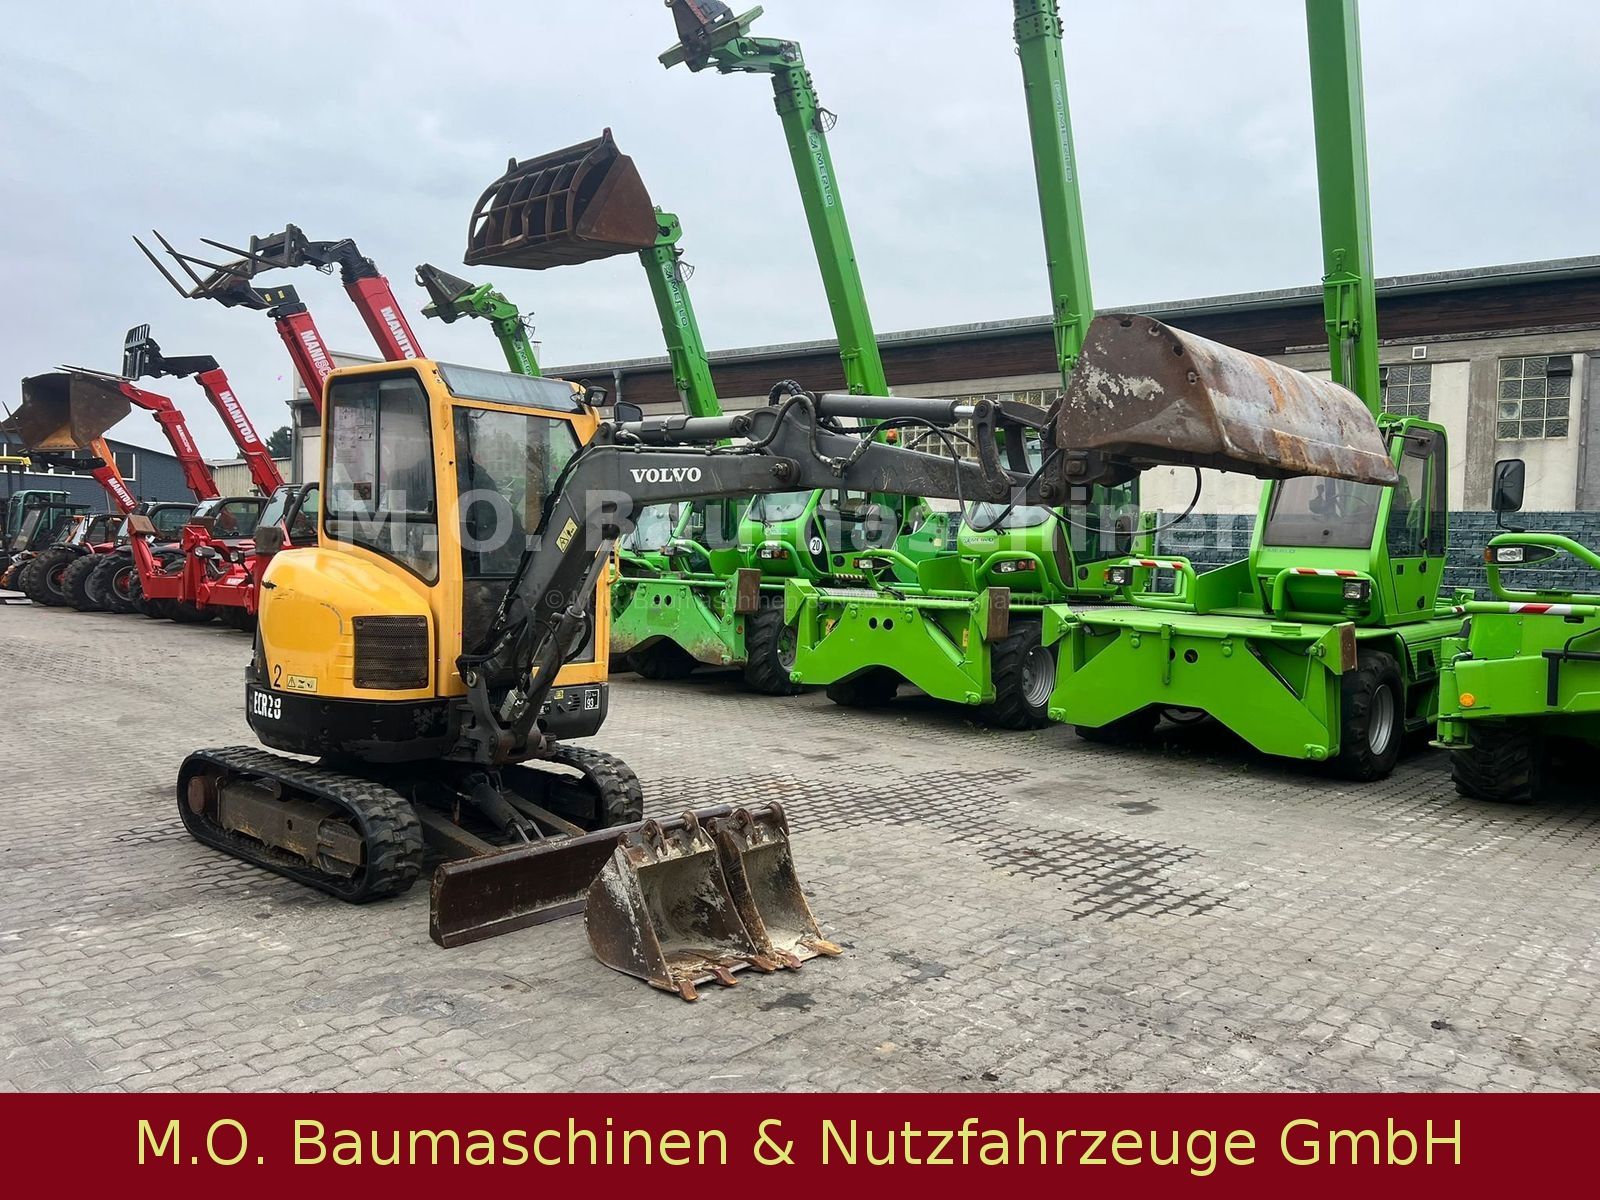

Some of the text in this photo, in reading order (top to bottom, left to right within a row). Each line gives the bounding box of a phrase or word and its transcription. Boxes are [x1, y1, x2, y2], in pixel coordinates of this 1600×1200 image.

[816, 151, 834, 206] MERLO
[380, 305, 417, 359] MANITO
[219, 391, 256, 444] MANITOU
[629, 467, 702, 483] VOLVO
[107, 477, 132, 506] MANITOU
[812, 539, 821, 552] 20
[273, 664, 282, 688] 2
[254, 691, 281, 720] ECR28
